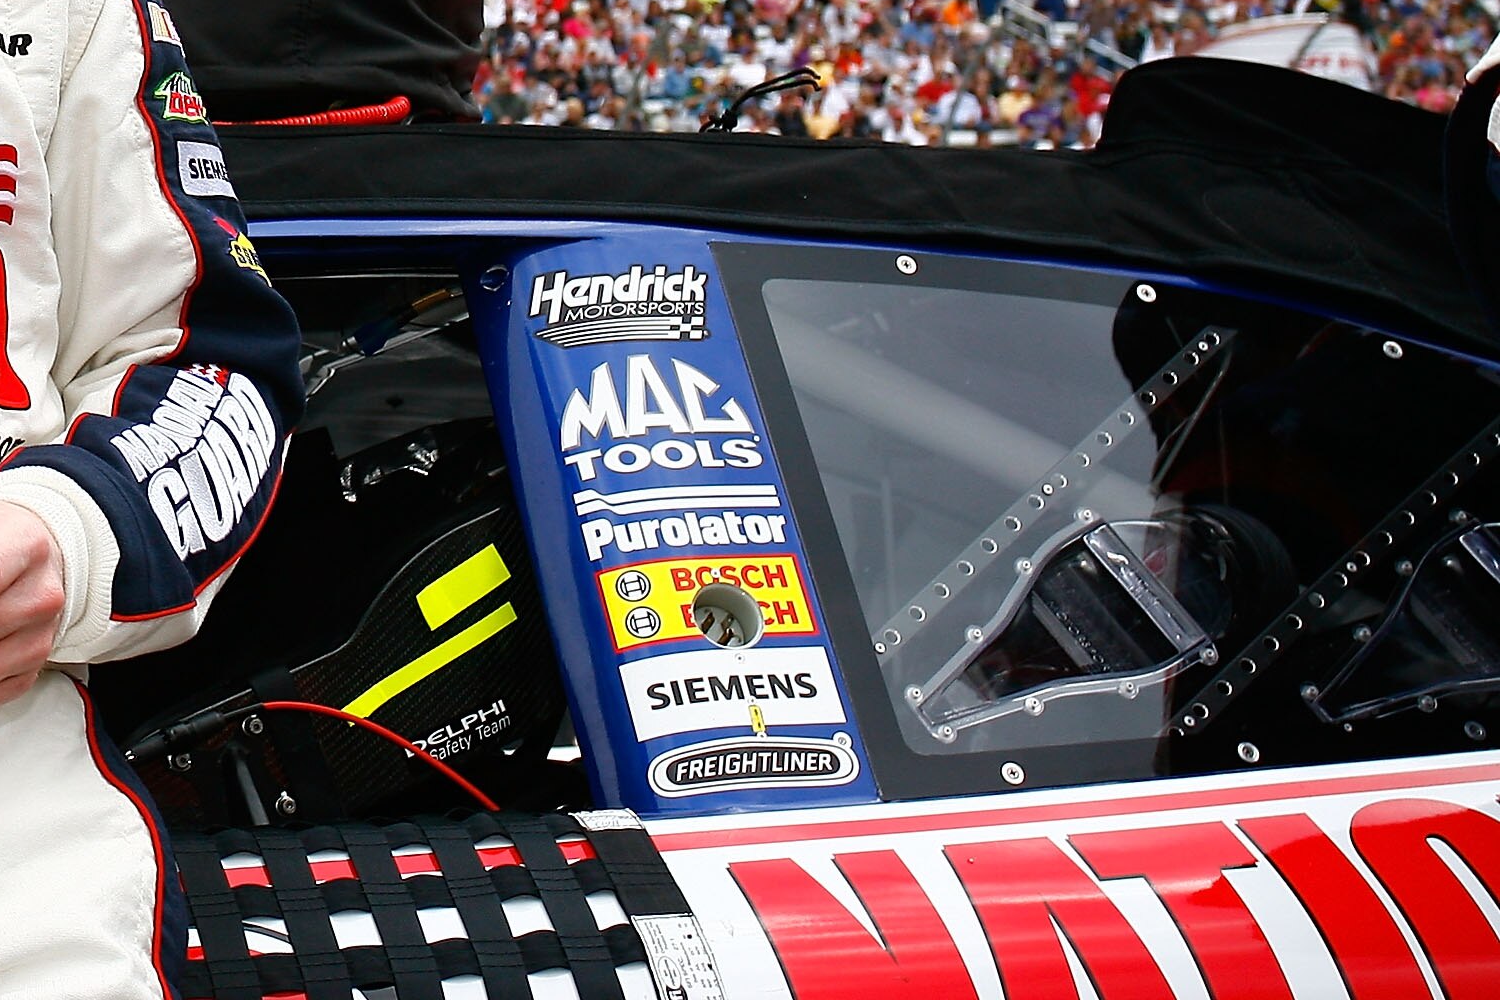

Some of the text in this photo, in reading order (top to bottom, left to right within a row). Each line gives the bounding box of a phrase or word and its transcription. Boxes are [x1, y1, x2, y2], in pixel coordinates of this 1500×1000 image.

[528, 265, 708, 325] Hendrick
[563, 301, 705, 324] MOTORSPORTS
[560, 353, 756, 452] MAC
[147, 371, 277, 562] GUARD
[564, 438, 764, 482] TOOLS
[580, 511, 787, 562] Purolator
[669, 564, 789, 592] BOSCH
[646, 672, 818, 711] SIEMENS
[404, 698, 507, 759] DELPHI
[429, 714, 511, 762] Safety Team
[674, 751, 835, 783] FREIGHTLINER
[726, 798, 1500, 1000] NATIO
